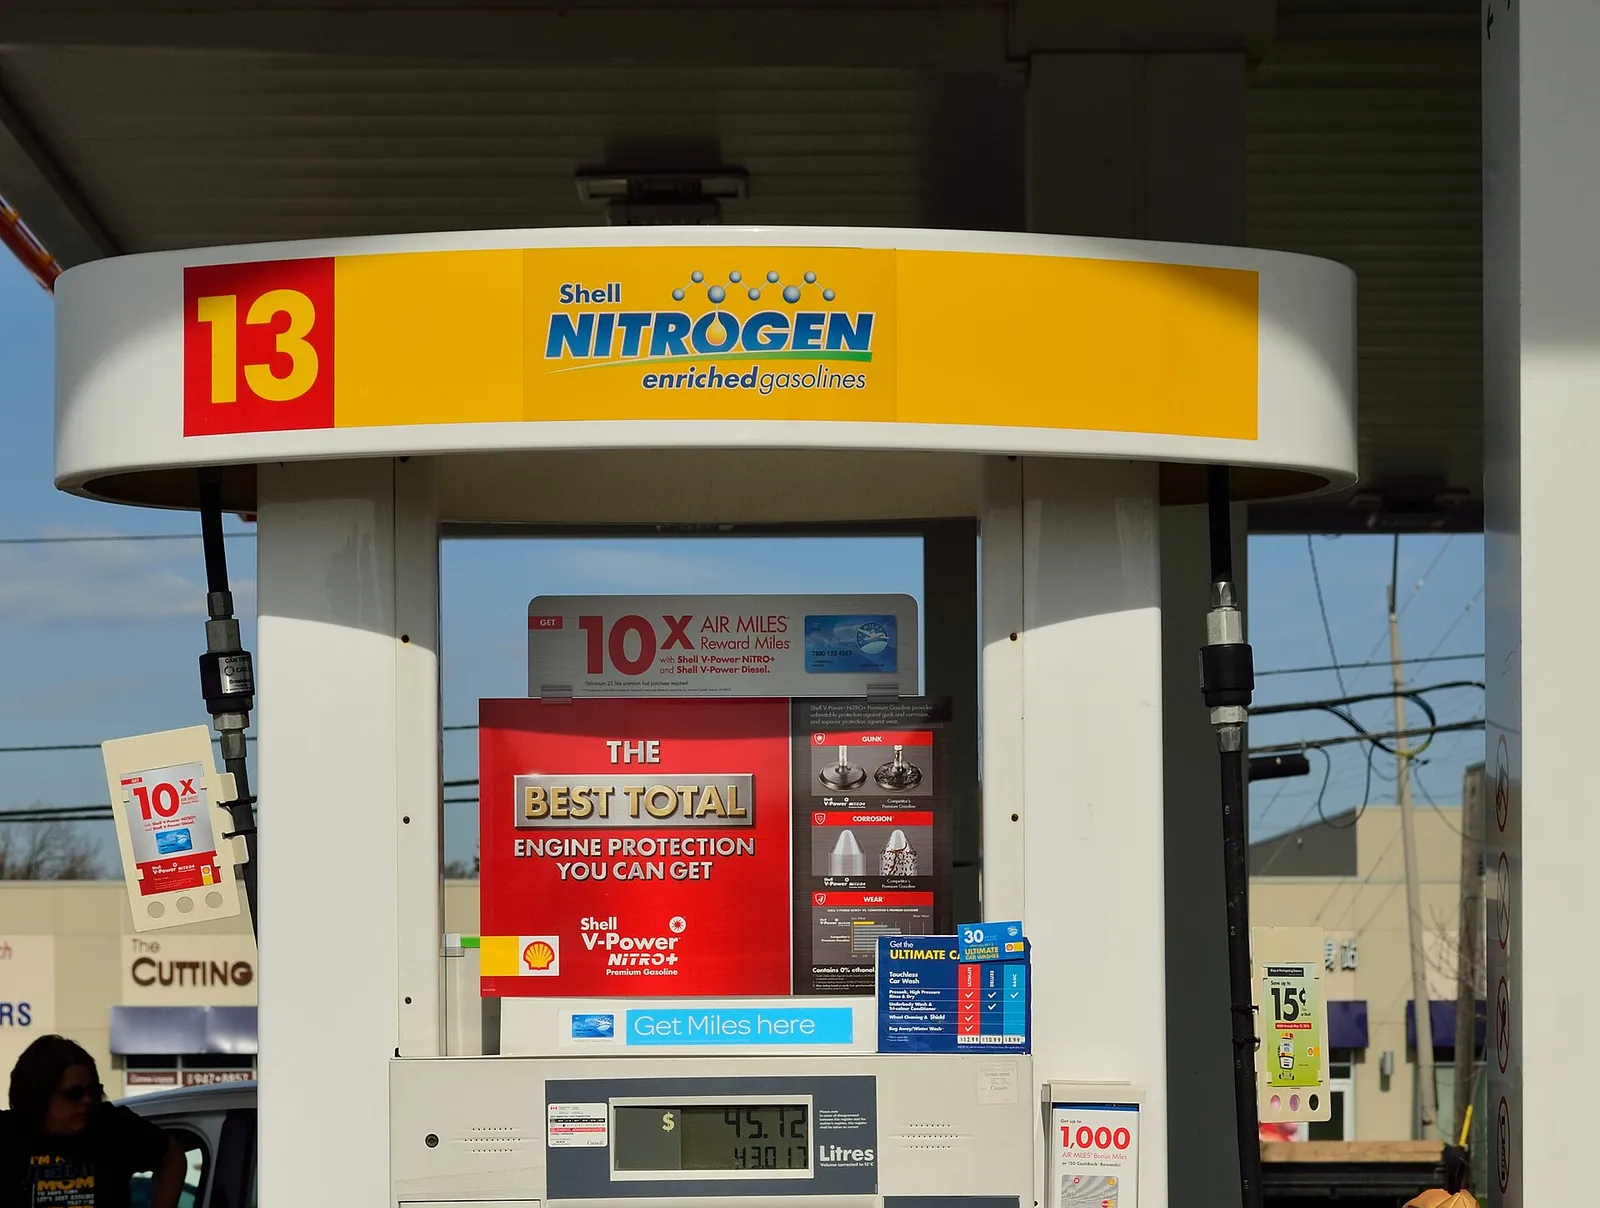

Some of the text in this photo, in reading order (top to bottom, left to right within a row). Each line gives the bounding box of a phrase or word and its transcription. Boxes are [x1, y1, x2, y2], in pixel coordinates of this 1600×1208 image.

[560, 283, 621, 303] Shell
[544, 311, 875, 359] NITROGEN
[198, 289, 318, 403] 13
[700, 616, 788, 633] AIR MILES
[701, 635, 750, 650] Reward
[660, 656, 775, 664] with Shell V-Power NiTRO+
[660, 666, 770, 674] and Shell V-Power Diesel.
[606, 740, 661, 764] THE
[524, 785, 748, 819] BEST TOTAL
[514, 838, 755, 857] ENGINE PROTECTION
[556, 862, 713, 880] YOU CAN GET
[580, 917, 617, 930] Shell
[582, 933, 678, 950] V-Power
[889, 940, 914, 948] Get the
[964, 929, 984, 943] 30
[131, 938, 161, 953] The
[965, 946, 999, 955] ULTIMATE
[890, 949, 946, 960] ULTIMATE
[131, 957, 253, 987] CUTTING
[643, 968, 678, 976] Gasoline
[1271, 988, 1306, 1021] 15¢
[634, 1014, 815, 1036] Get Miles here
[662, 1111, 675, 1132] $
[724, 1108, 807, 1139] 45.12
[1060, 1126, 1131, 1150] 1,000
[820, 1145, 874, 1161] Litres
[36, 1175, 95, 1191] MOM
